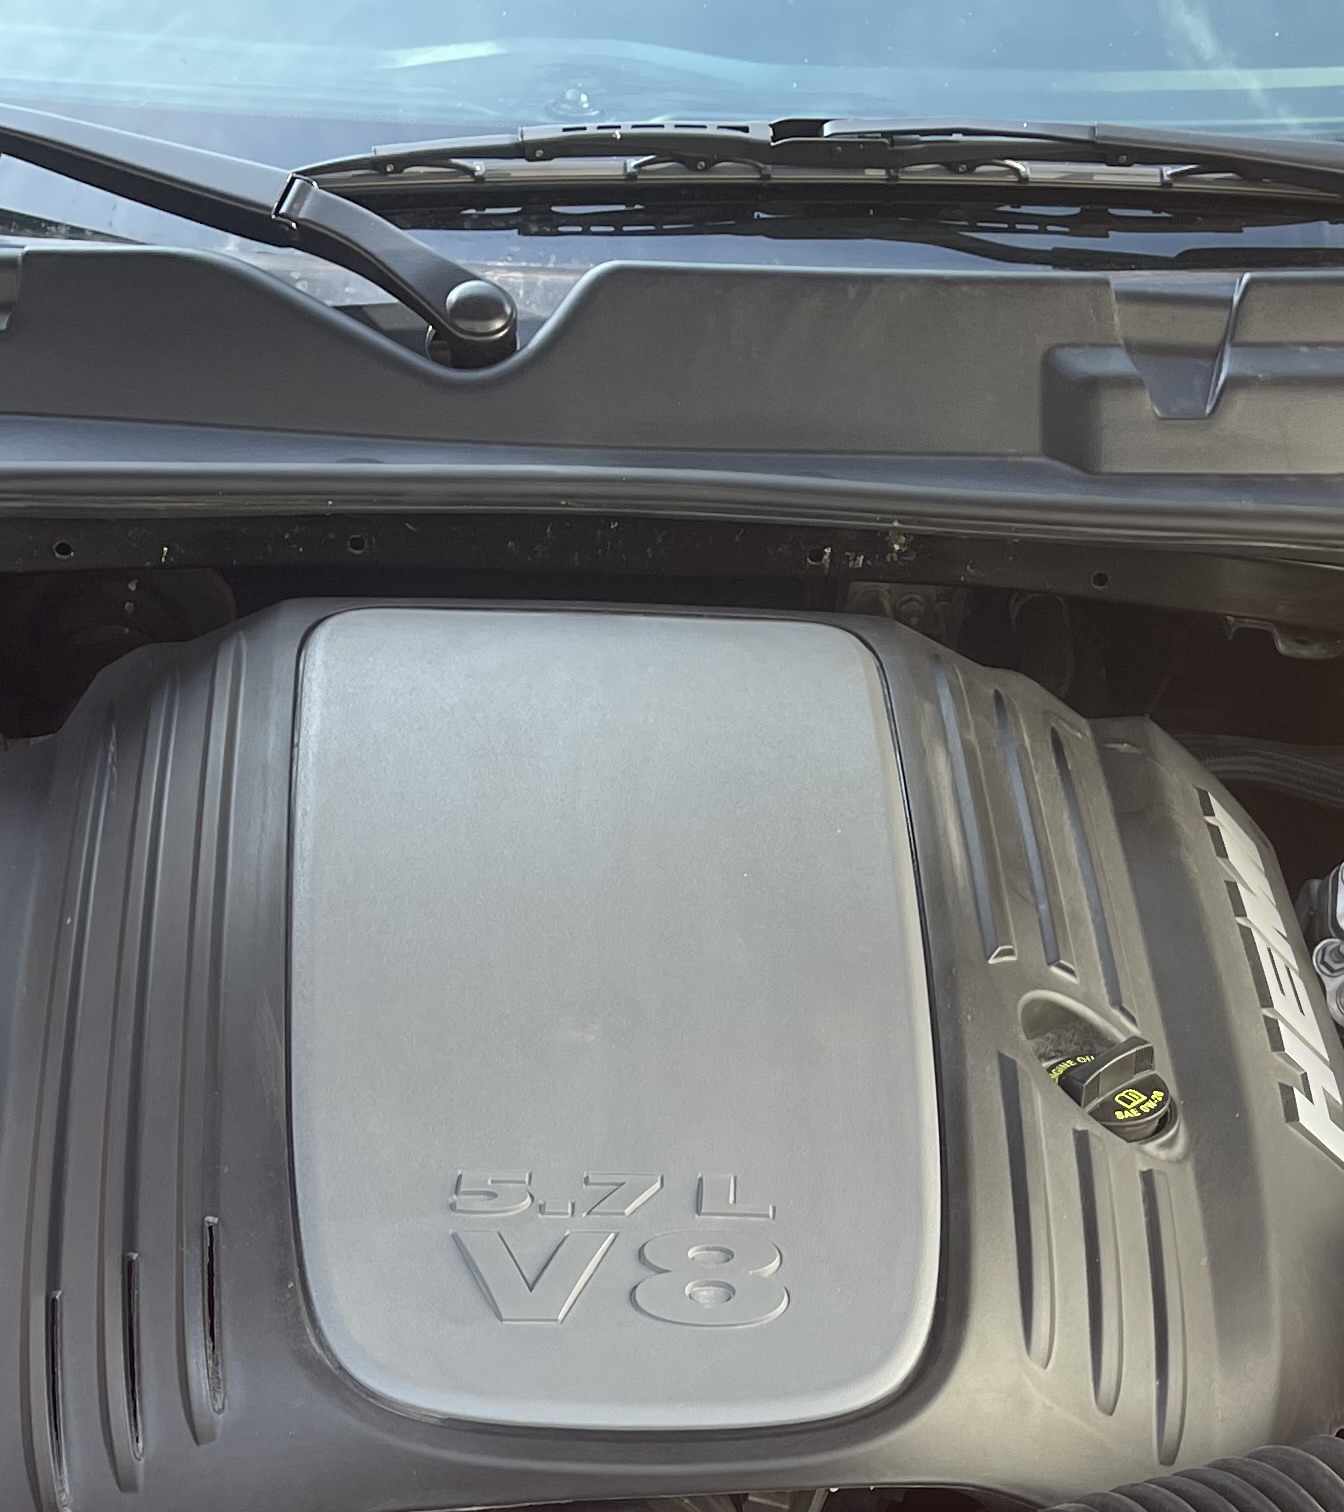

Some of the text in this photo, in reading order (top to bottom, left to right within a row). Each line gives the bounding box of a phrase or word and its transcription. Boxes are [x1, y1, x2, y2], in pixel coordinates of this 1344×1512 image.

[1114, 1089, 1166, 1120] SAE 0W-20
[448, 1170, 777, 1221] 5.7 L
[448, 1229, 792, 1329] V8
